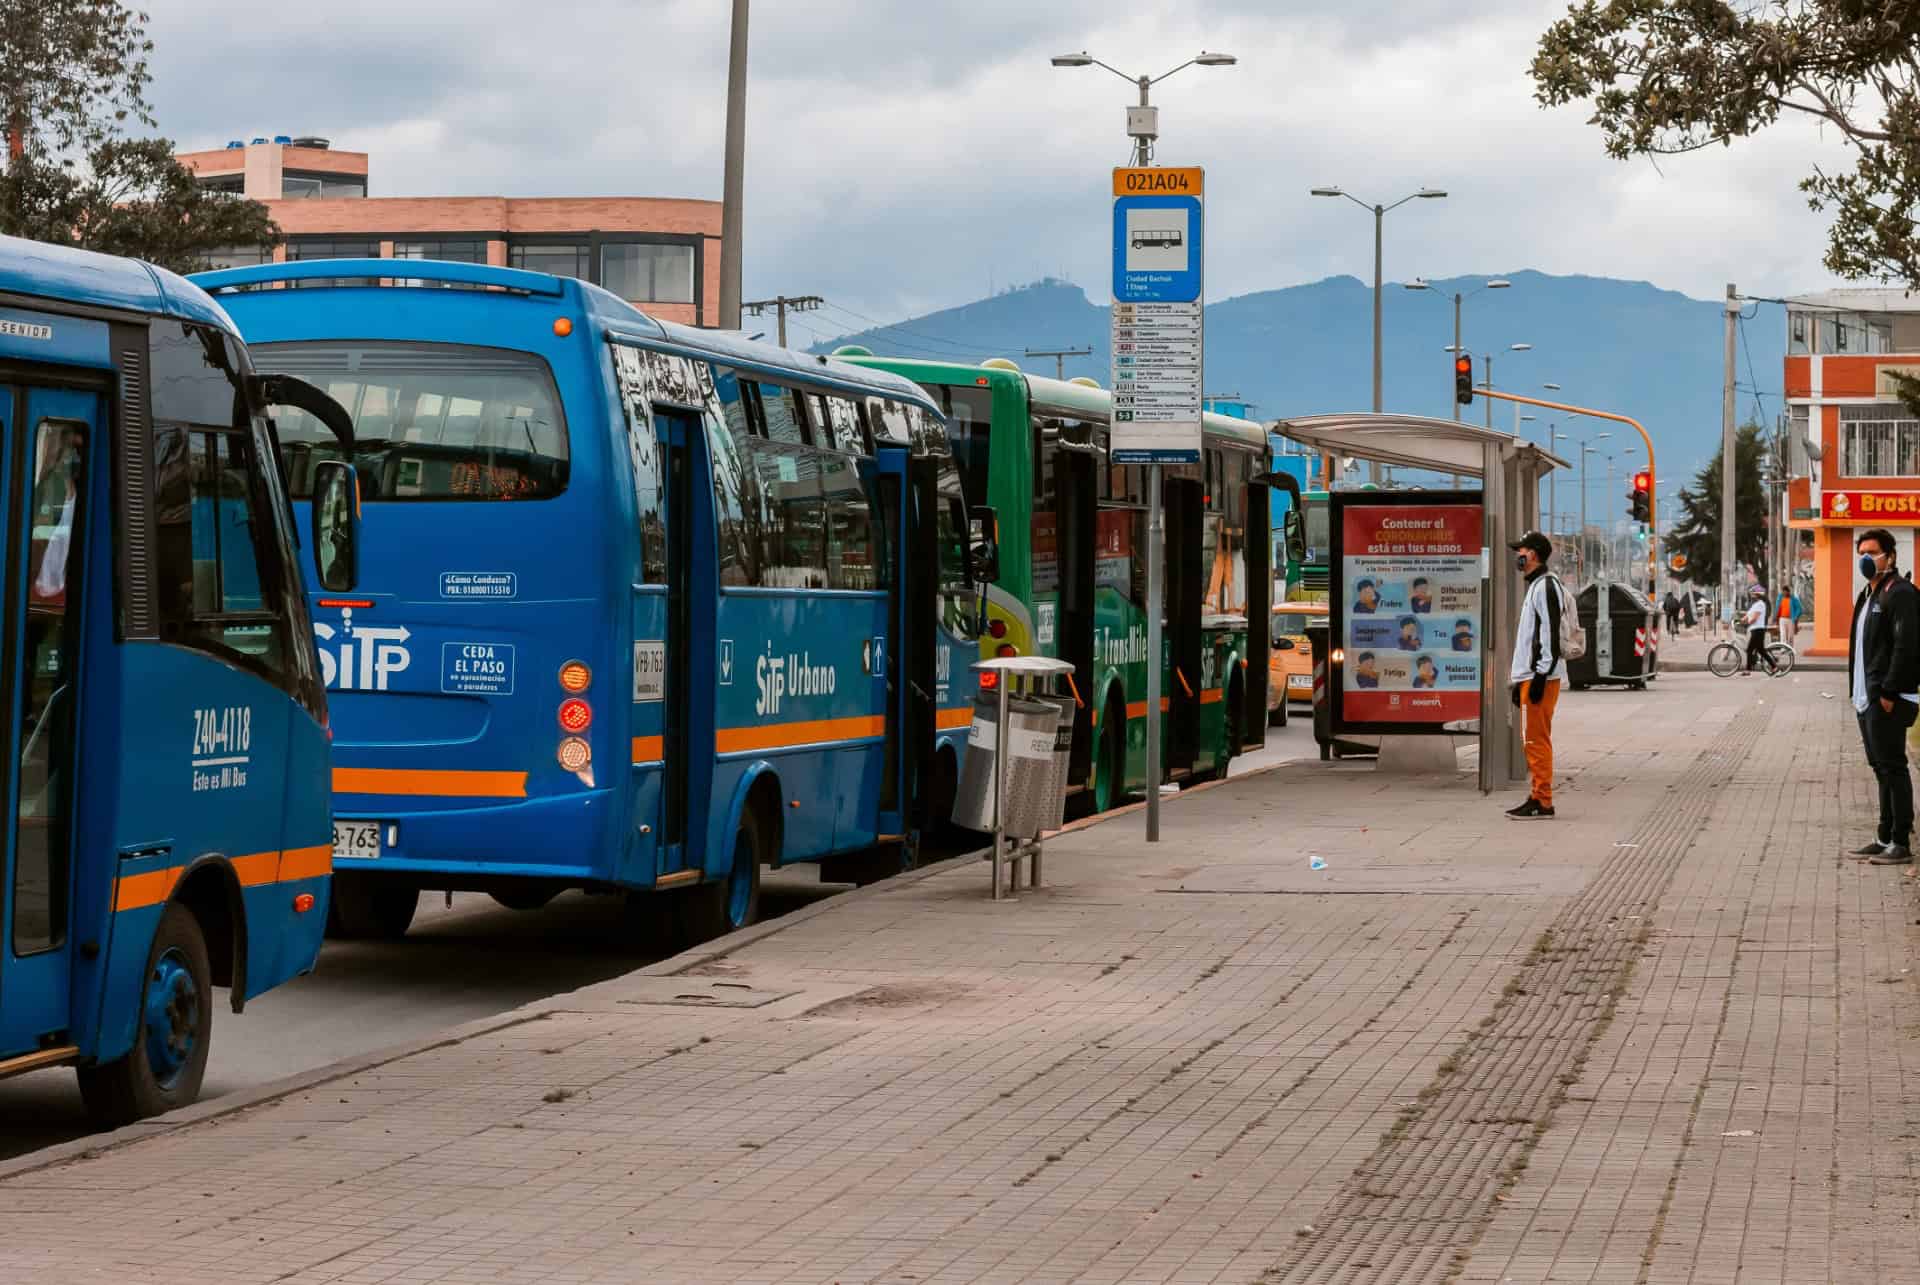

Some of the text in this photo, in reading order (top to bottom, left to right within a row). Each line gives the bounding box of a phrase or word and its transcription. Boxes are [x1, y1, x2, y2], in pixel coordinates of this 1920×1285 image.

[1126, 173, 1188, 191] 021A04
[1, 322, 49, 337] SENIOR
[1861, 493, 1920, 513] Brost
[1382, 516, 1444, 529] Contener el
[1367, 542, 1462, 553] está en tus manos
[462, 645, 495, 659] CEDA
[455, 659, 505, 674] EL PASO
[788, 650, 836, 697] Urbano
[192, 706, 251, 754] Z40-4118
[193, 766, 247, 792] Este es Mi Bus
